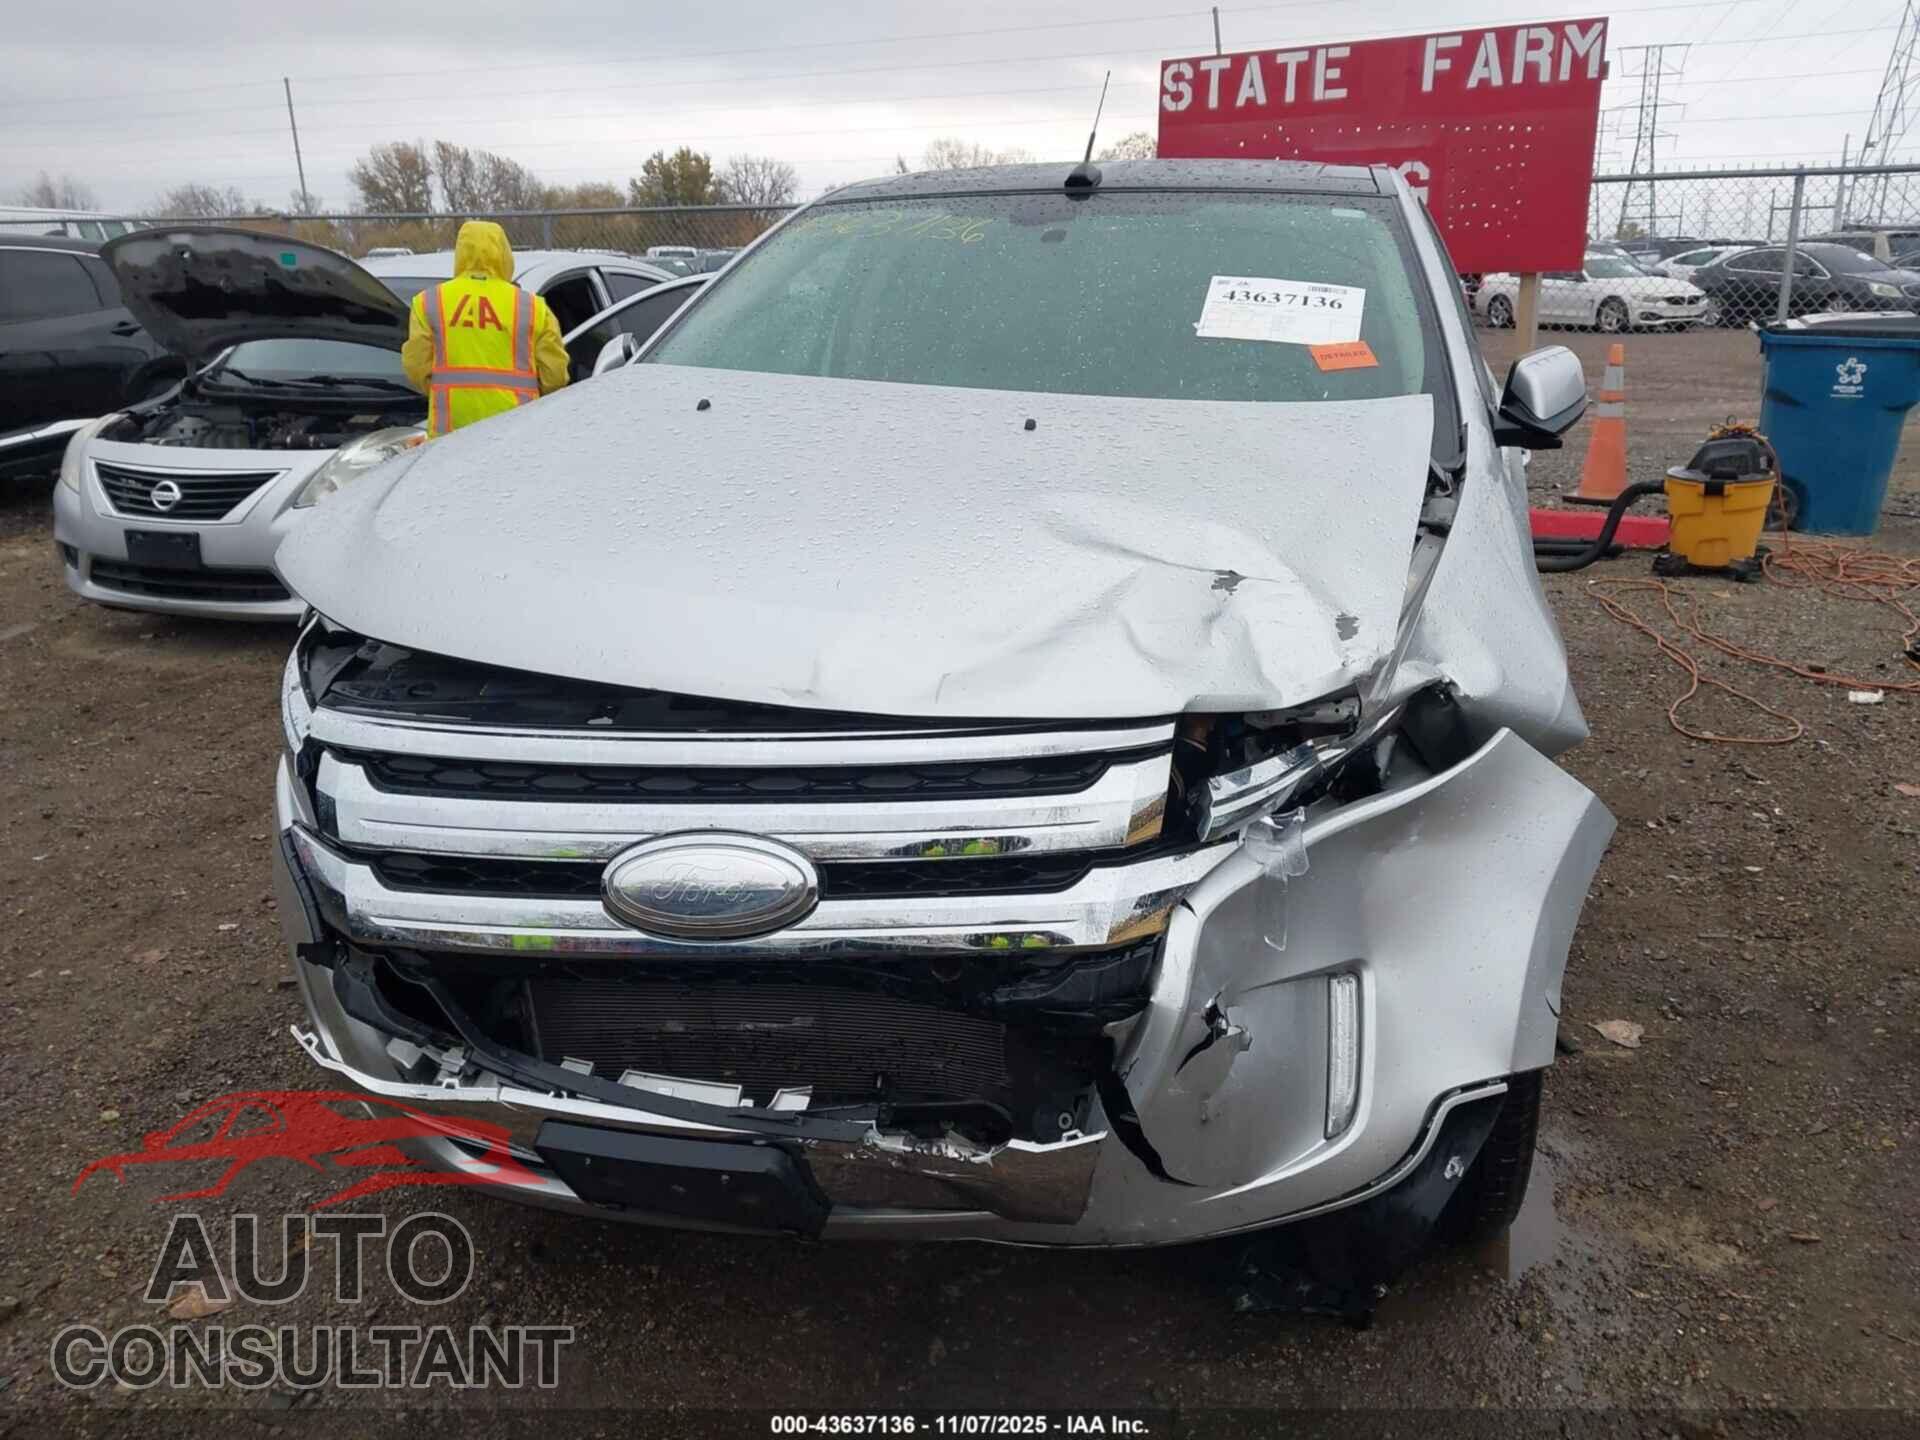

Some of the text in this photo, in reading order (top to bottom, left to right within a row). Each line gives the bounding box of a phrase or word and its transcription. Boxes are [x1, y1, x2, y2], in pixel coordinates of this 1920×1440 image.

[1162, 22, 1605, 112] STATE FARM
[1222, 289, 1343, 310] 43637136
[651, 862, 753, 906] Ford
